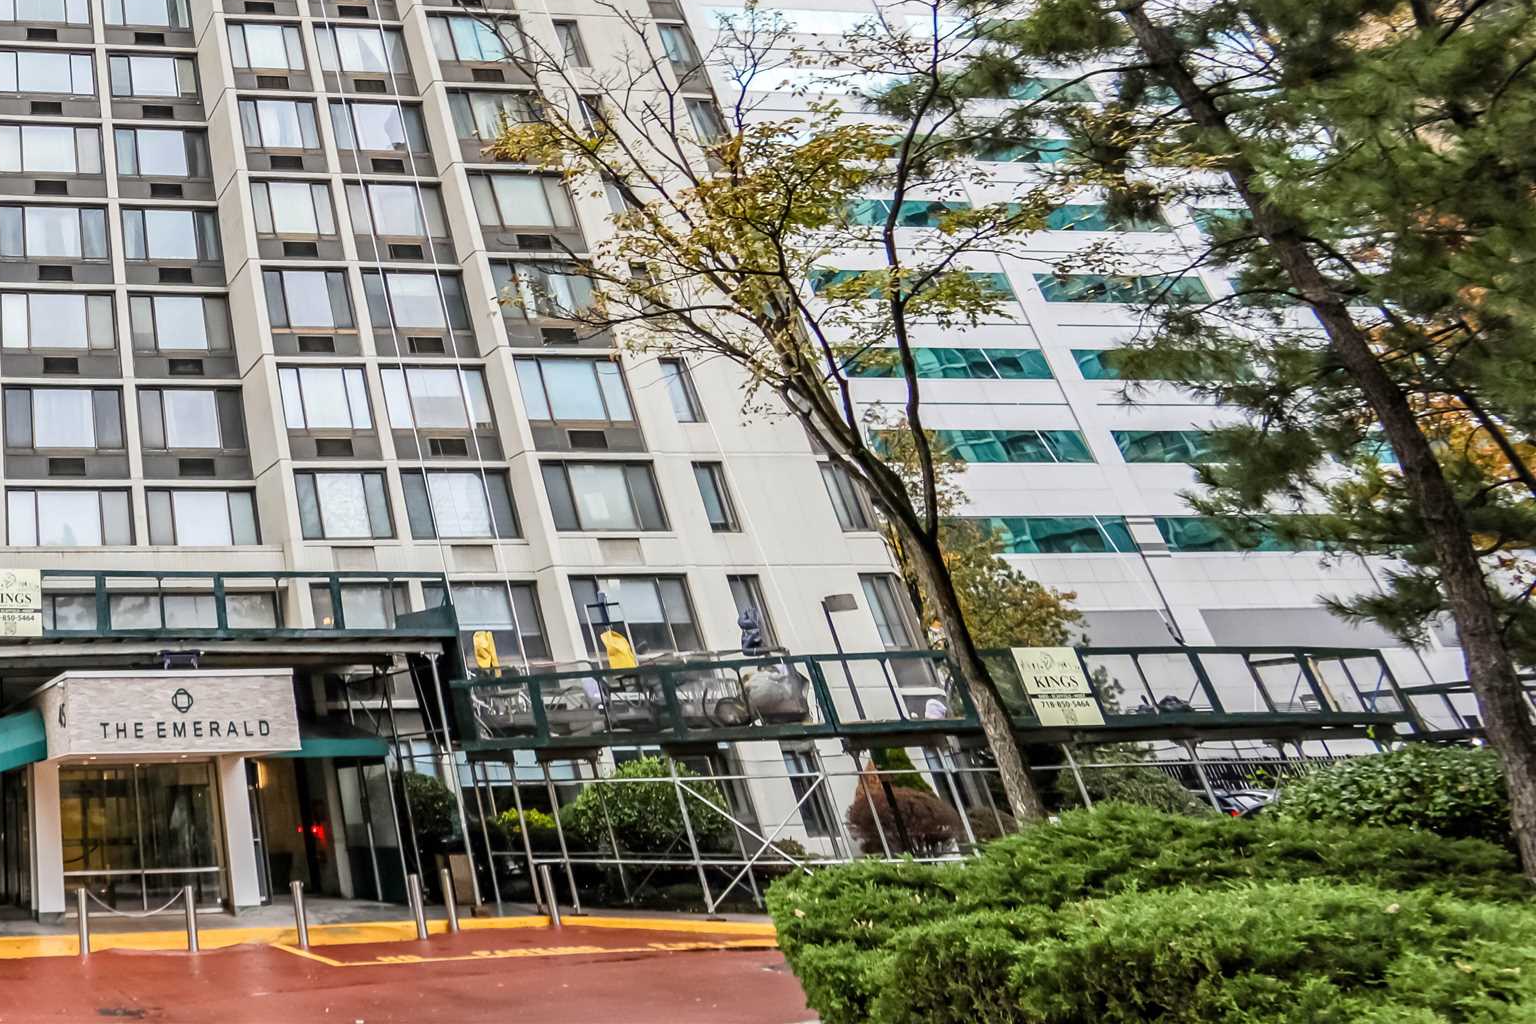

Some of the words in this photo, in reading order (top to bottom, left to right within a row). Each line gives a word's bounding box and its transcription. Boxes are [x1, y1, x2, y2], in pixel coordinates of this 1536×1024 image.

[1033, 675, 1079, 688] KINGS
[99, 721, 144, 739] THE
[156, 719, 270, 739] EMERALD
